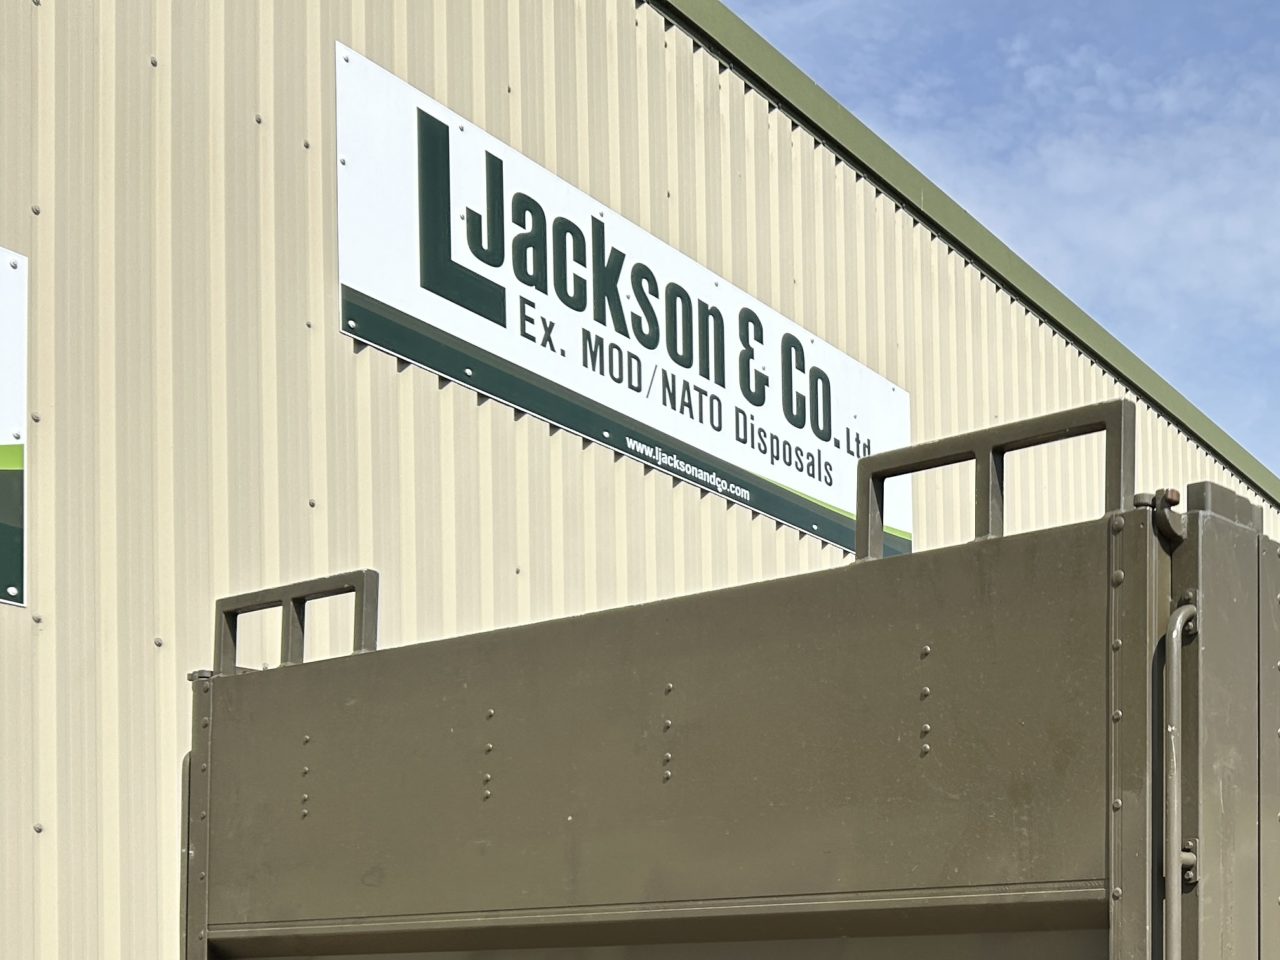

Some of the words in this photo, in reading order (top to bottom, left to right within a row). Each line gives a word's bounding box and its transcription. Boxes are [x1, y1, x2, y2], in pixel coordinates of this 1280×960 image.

[519, 296, 566, 357] Ex.
[581, 328, 723, 433] MOD/NATO
[735, 406, 834, 487] Disposals
[737, 306, 770, 407] &
[625, 436, 750, 501] www.ljacksonandco.com
